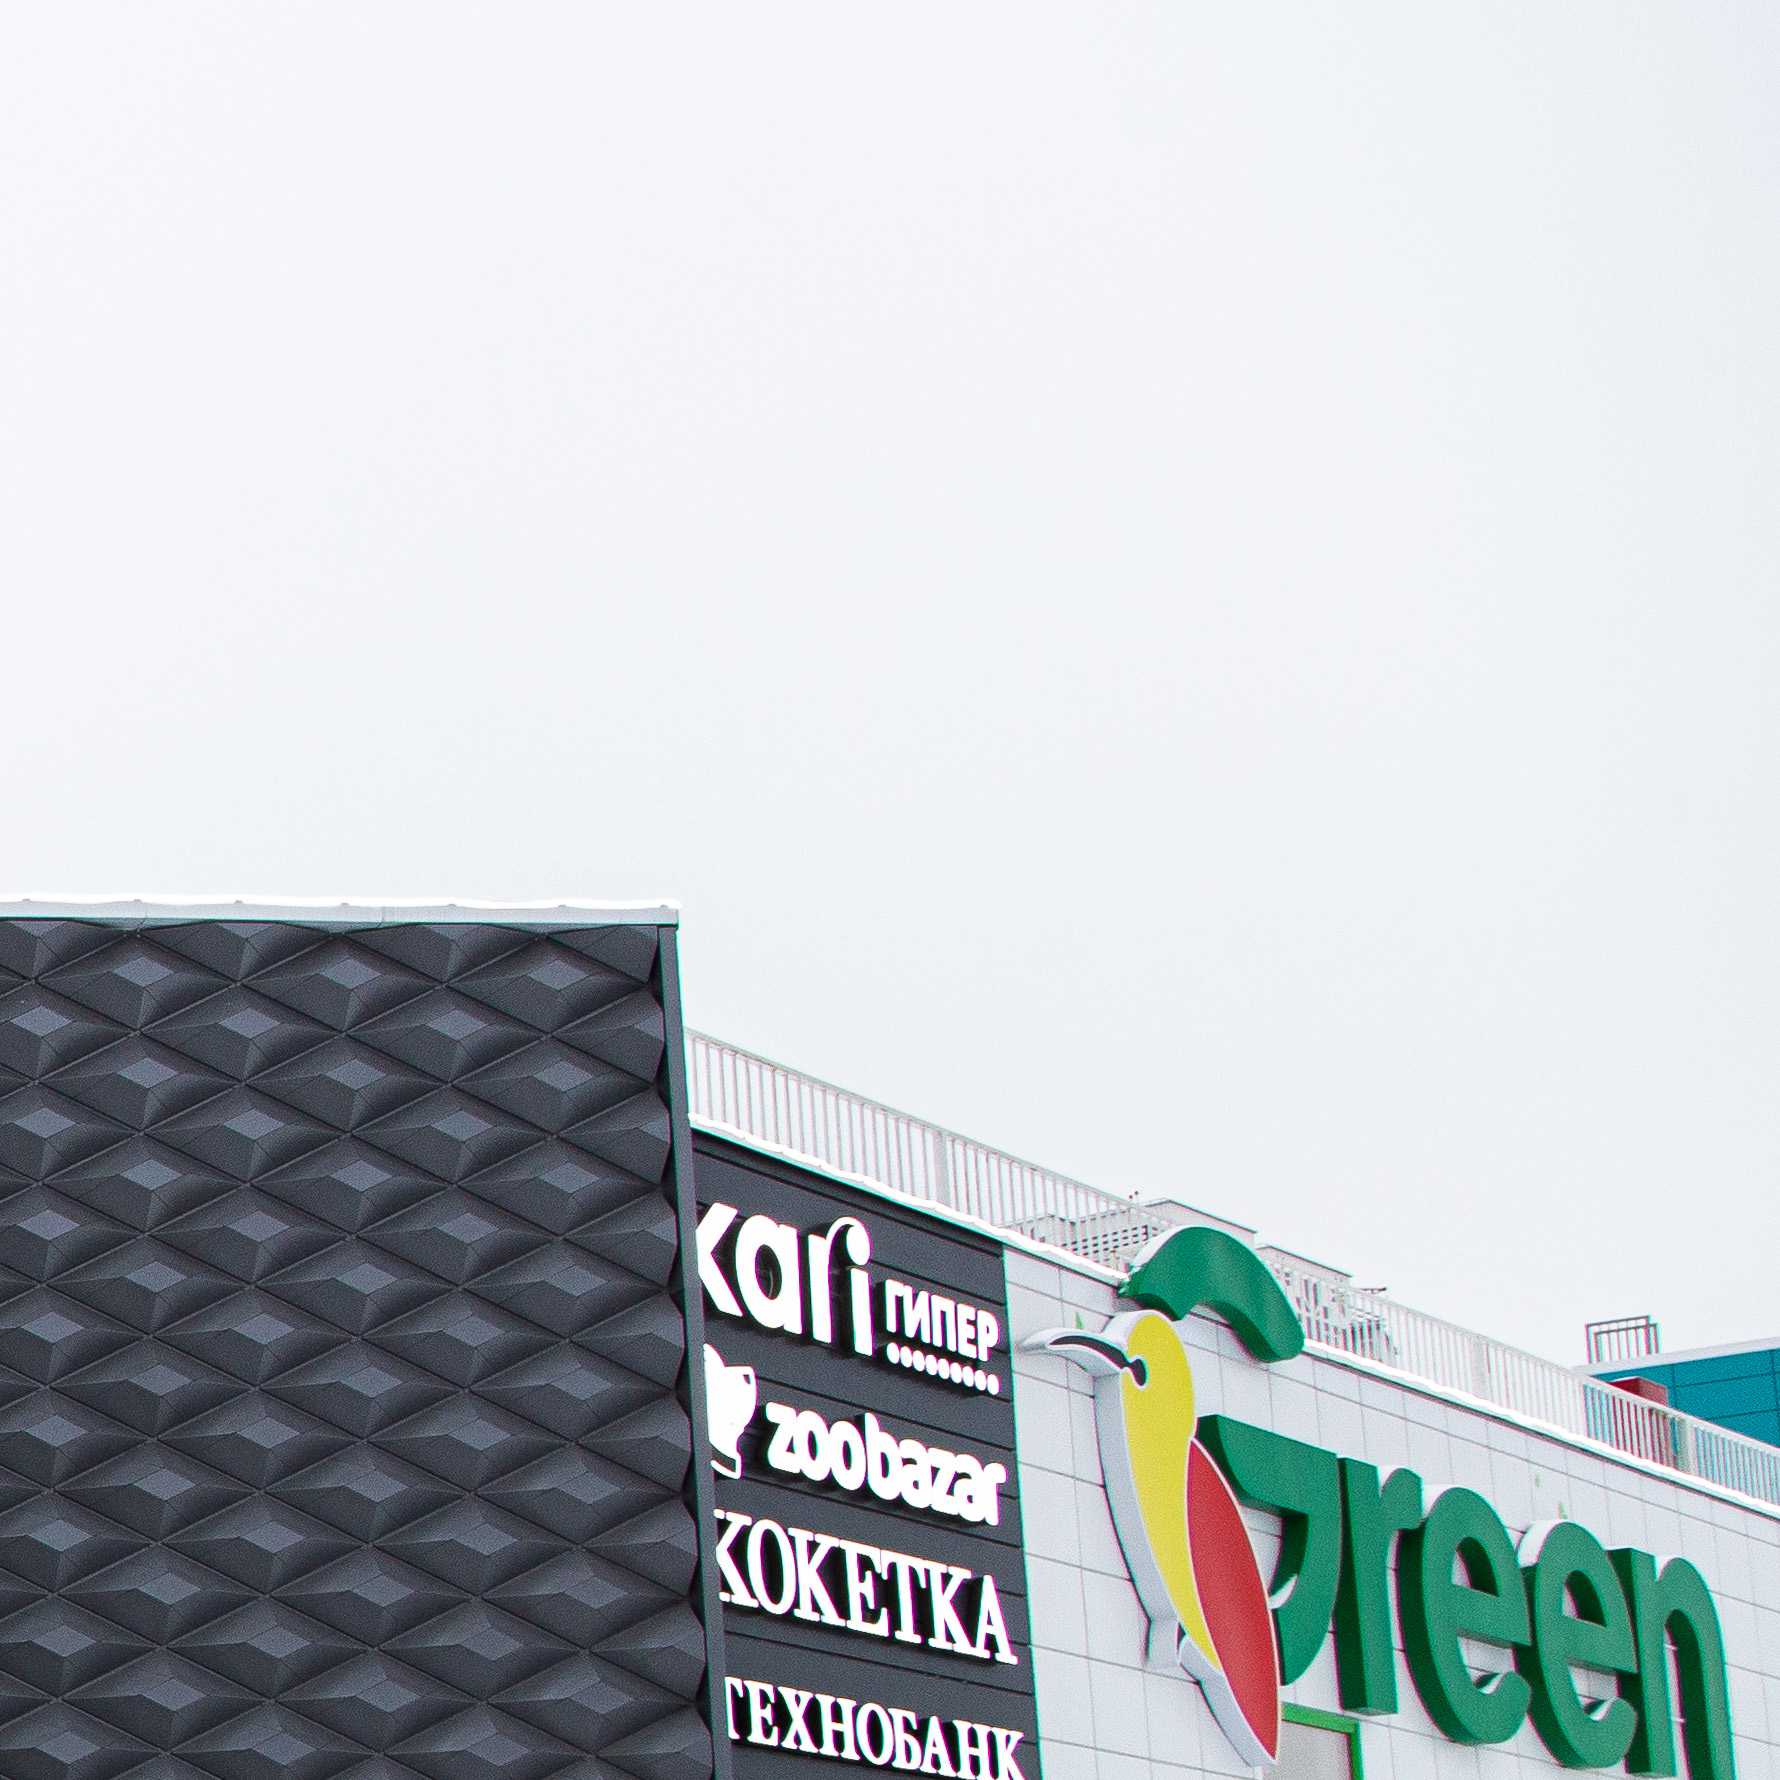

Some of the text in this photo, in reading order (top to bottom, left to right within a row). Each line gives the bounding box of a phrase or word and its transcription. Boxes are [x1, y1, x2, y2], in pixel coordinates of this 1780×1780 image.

[885, 1279, 1000, 1361] ГИПЕР
[765, 1402, 1008, 1526] zoobazar
[713, 1508, 1019, 1665] КОКЕТКА
